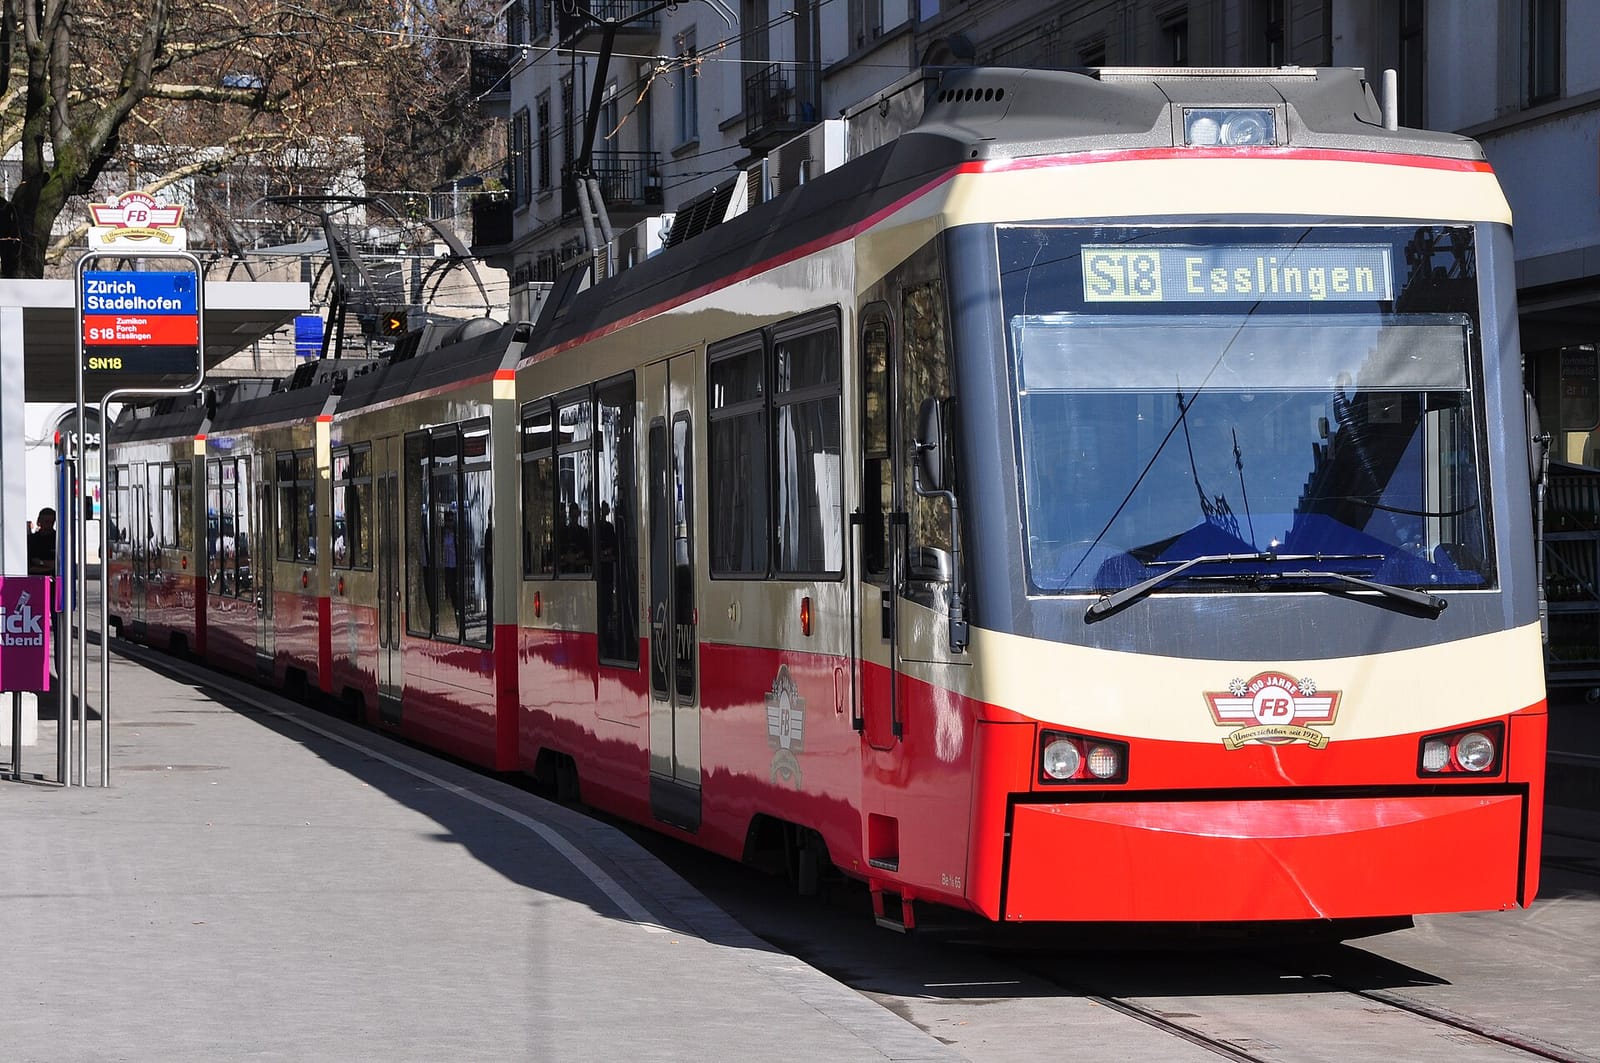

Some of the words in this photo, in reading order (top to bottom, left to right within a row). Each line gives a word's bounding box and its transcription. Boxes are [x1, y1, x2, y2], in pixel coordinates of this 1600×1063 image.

[132, 195, 154, 208] JAHRE
[127, 210, 148, 222] FB
[1090, 254, 1158, 297] S18
[1185, 257, 1375, 300] Esslingen
[87, 280, 136, 294] Zürich
[87, 296, 182, 310] Stadelhofen
[116, 332, 152, 341] Esslingen
[88, 357, 122, 370] SN18
[1249, 680, 1264, 694] 100
[1266, 676, 1298, 695] JAHRE
[1259, 698, 1290, 717] FB
[780, 708, 790, 737] FB
[1303, 730, 1320, 741] 1912
